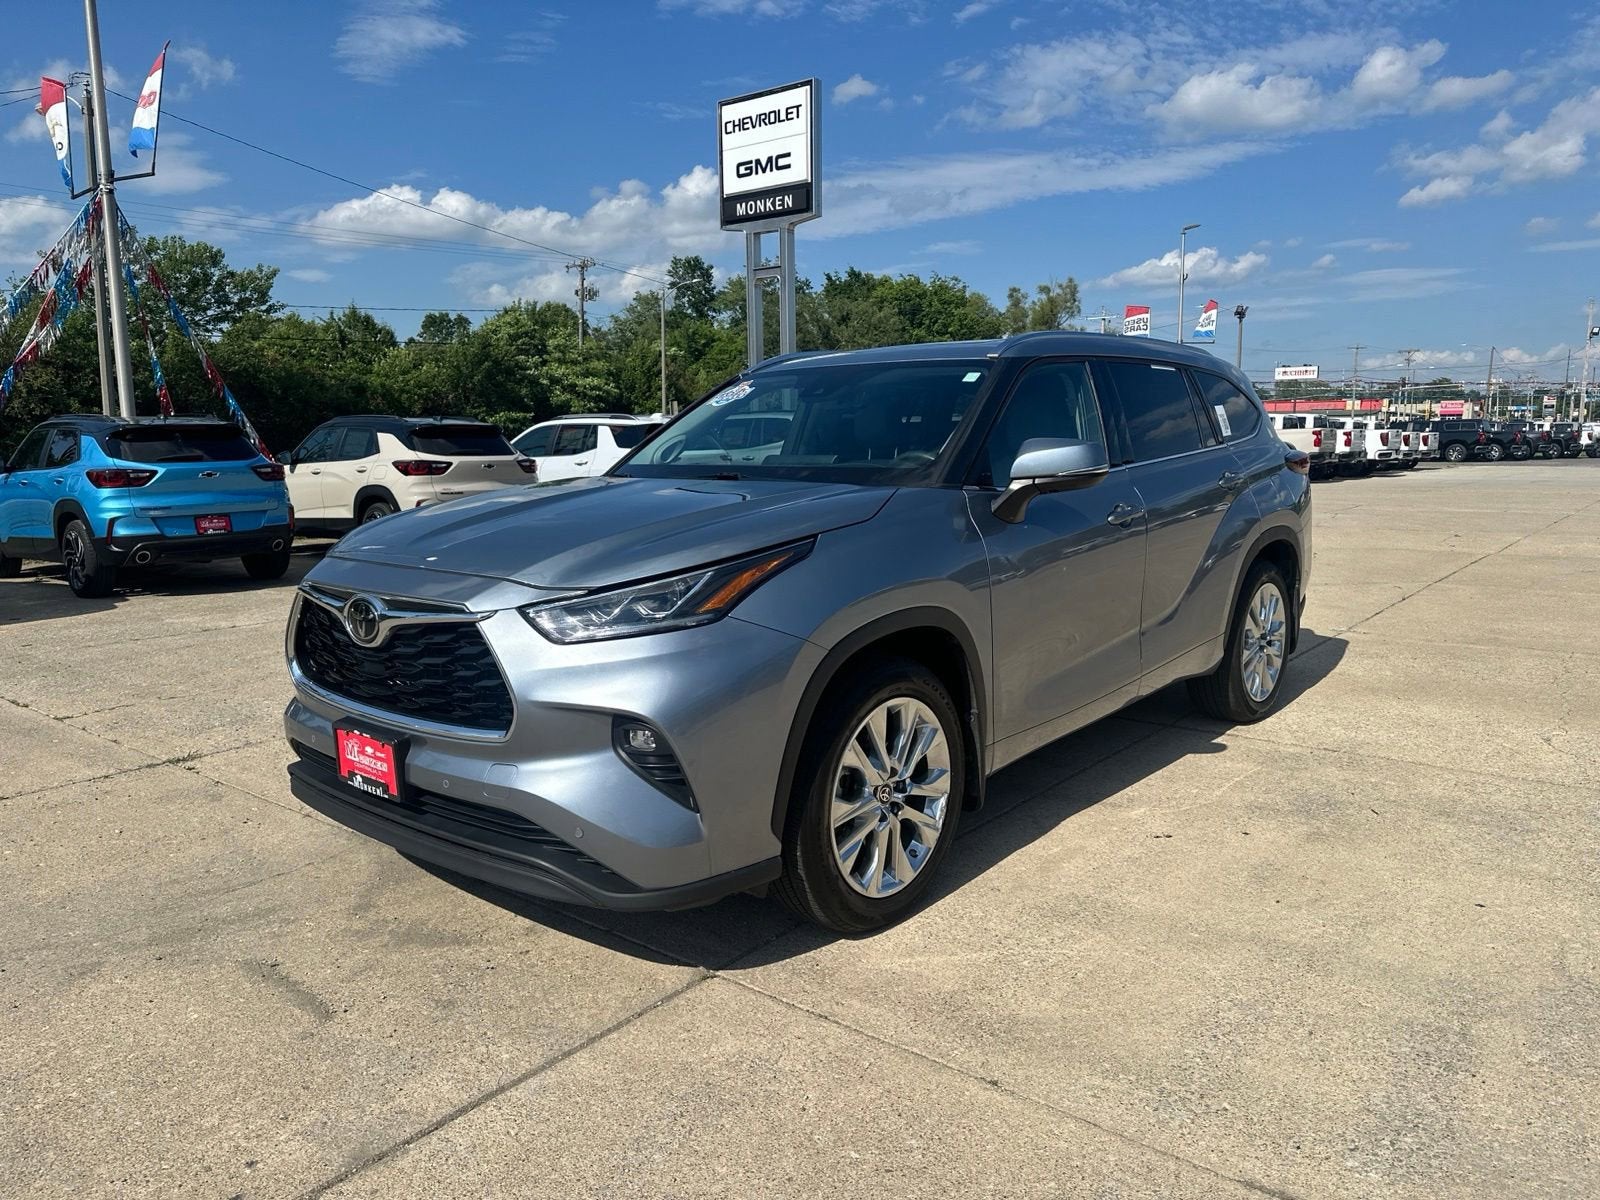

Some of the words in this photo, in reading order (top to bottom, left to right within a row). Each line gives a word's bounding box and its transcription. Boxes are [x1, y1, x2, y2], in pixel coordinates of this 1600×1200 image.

[724, 104, 802, 135] CHEVROLET
[736, 152, 791, 178] GMC
[736, 194, 793, 216] MONKEN
